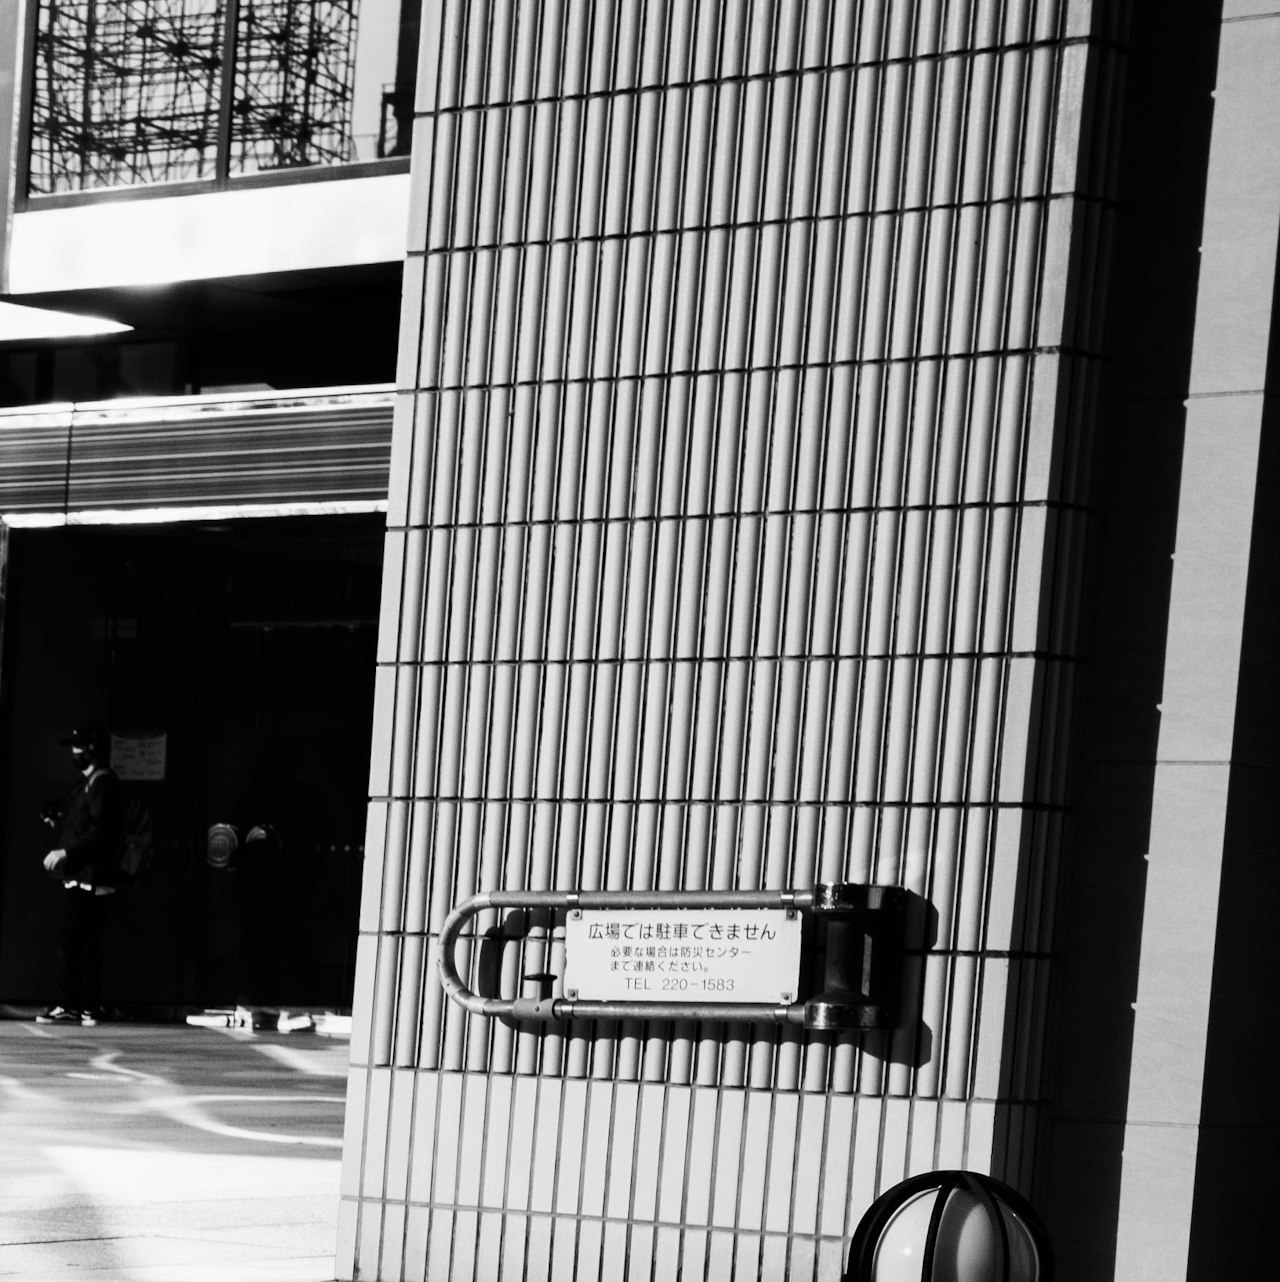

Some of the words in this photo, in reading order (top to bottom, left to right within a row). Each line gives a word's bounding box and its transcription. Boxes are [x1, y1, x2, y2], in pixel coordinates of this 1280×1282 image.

[588, 922, 776, 940] 広場では駐車できません
[610, 946, 752, 958] 必要な場合は防災センター
[610, 961, 709, 972] まで連絡ください。
[625, 977, 651, 990] TEL
[662, 979, 735, 991] 220-1583
